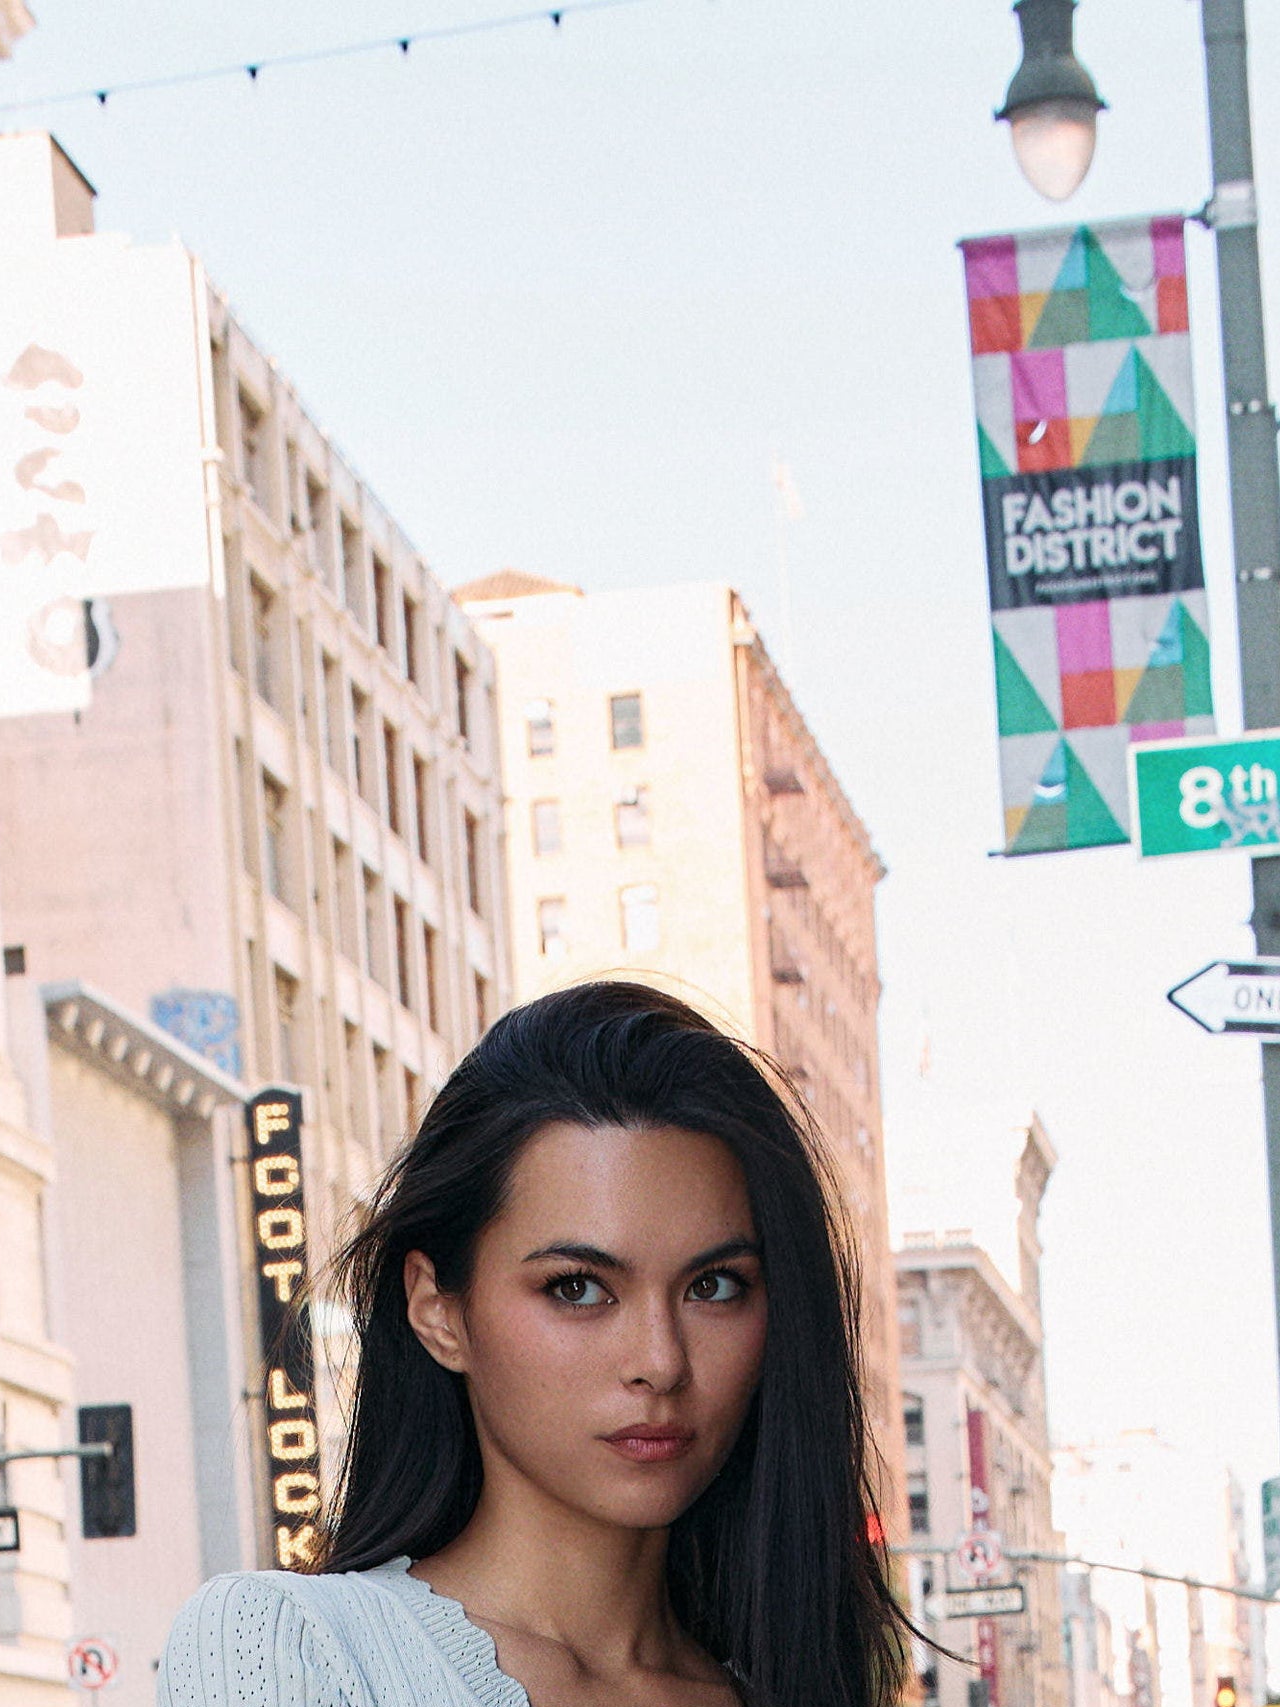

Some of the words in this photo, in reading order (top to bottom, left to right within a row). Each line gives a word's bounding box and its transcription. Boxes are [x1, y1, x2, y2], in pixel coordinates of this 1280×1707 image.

[1002, 475, 1182, 535] FASHION
[1004, 517, 1183, 575] DISTRICT
[1179, 762, 1278, 829] 8th
[254, 1102, 305, 1302] FOOT
